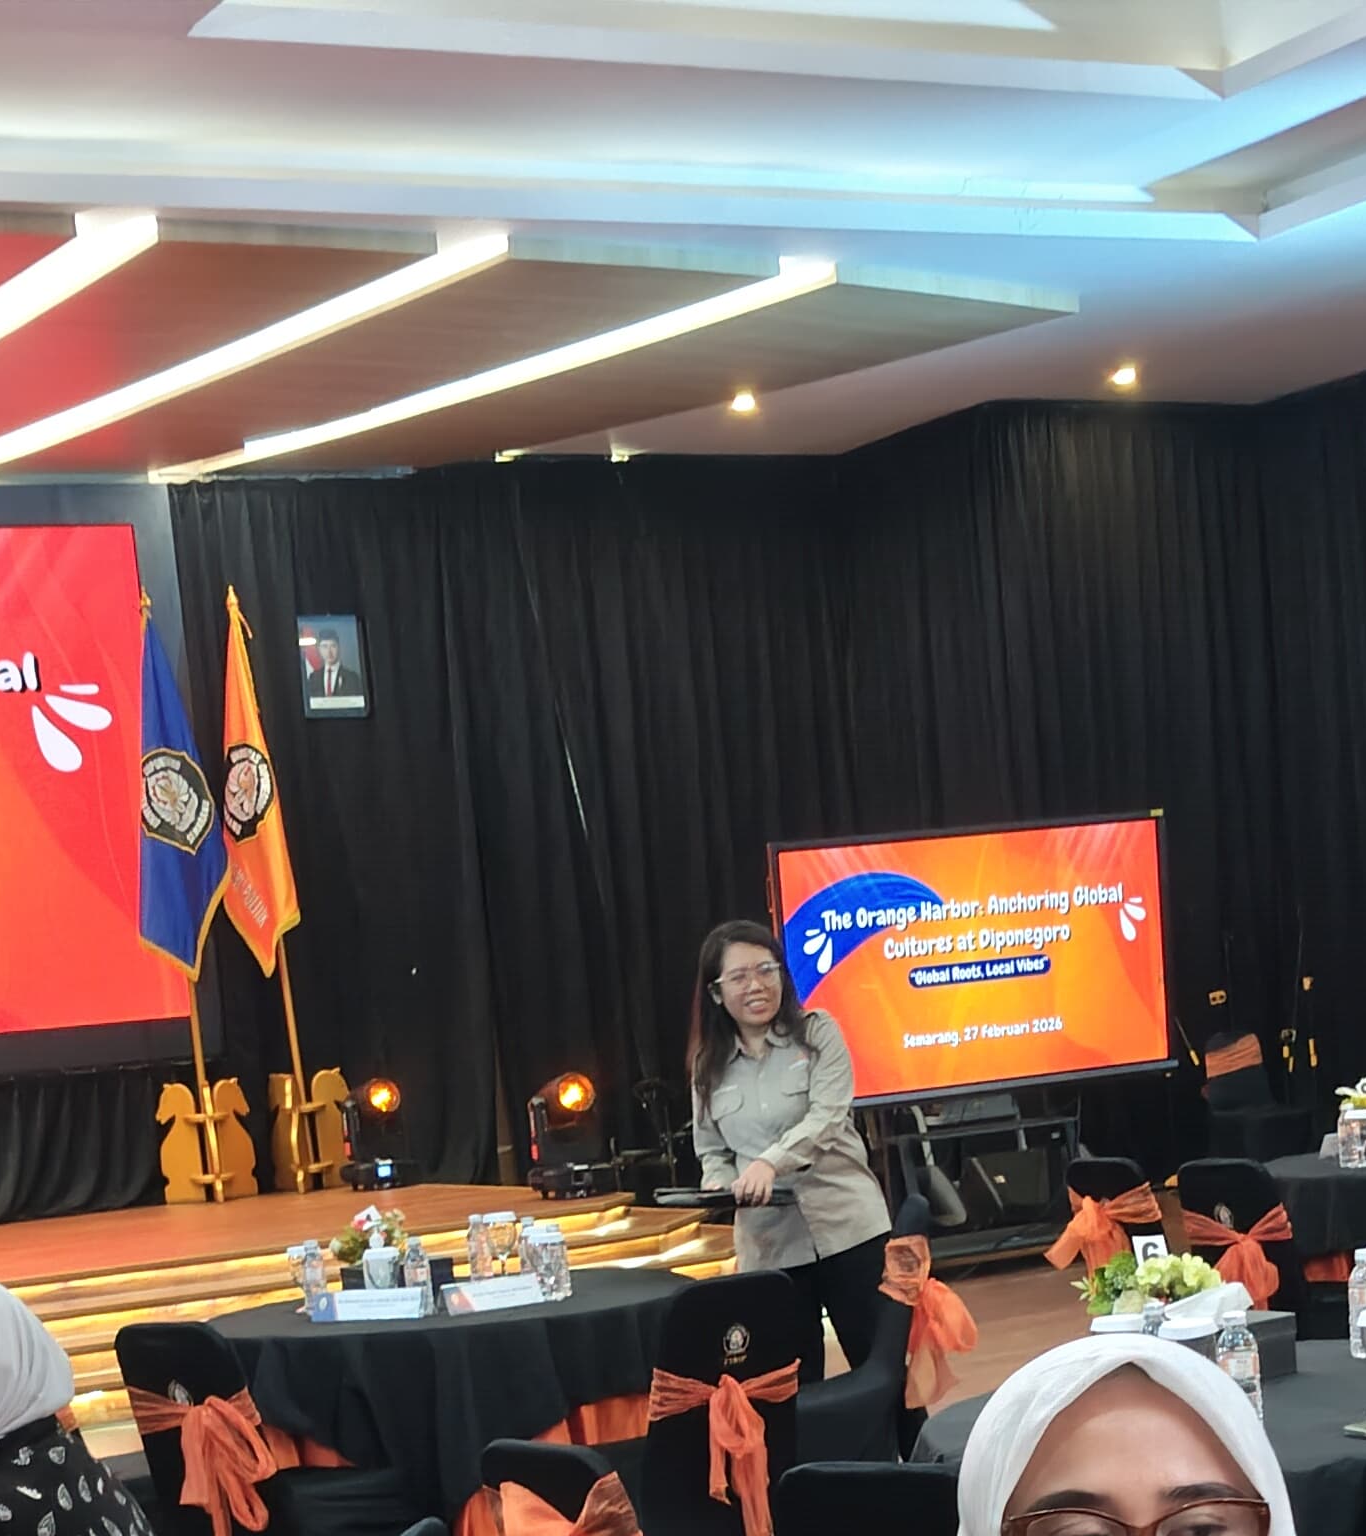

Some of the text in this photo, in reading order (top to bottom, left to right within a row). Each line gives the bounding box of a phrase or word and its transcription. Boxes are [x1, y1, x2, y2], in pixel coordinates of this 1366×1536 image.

[821, 882, 1123, 932] The Orange Harbor: Anchoring Global
[883, 924, 1071, 960] Cultures at Diponegoro
[986, 958, 1014, 976] Local
[964, 1025, 979, 1041] 27
[981, 1020, 1029, 1038] Februari
[1032, 1016, 1063, 1033] 2026
